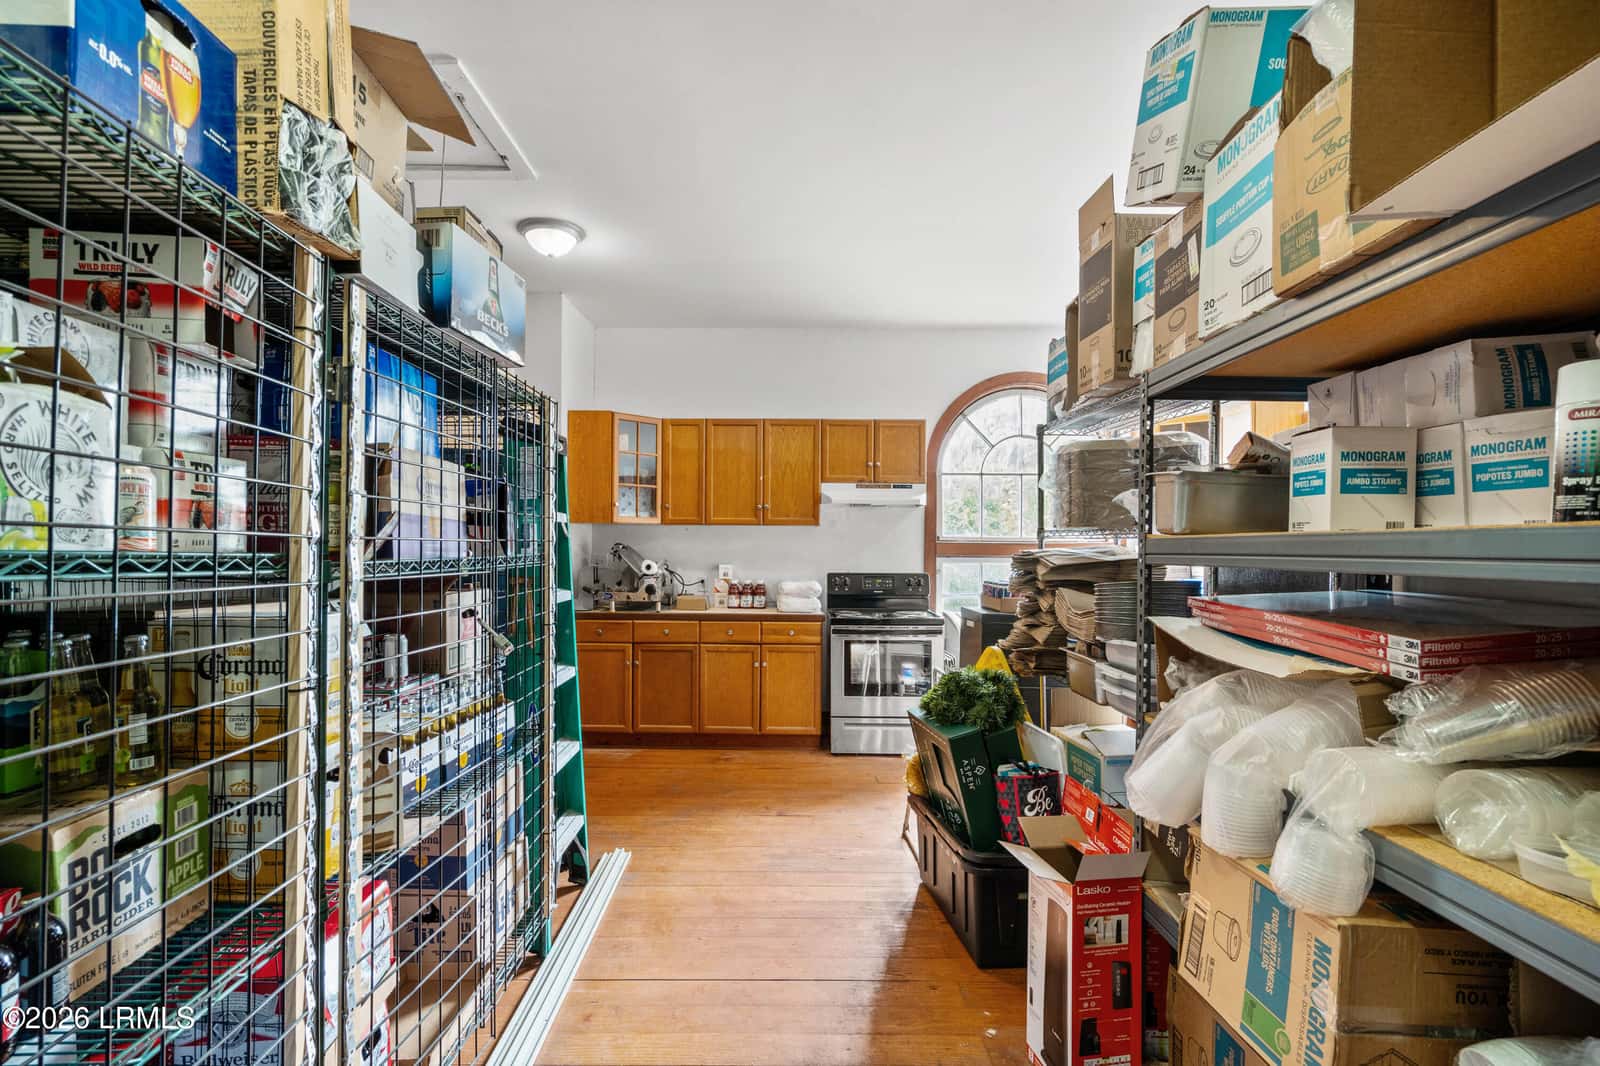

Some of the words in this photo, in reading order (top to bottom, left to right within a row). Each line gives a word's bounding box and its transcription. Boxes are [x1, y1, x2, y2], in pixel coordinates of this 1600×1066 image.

[1210, 10, 1264, 22] MONOGRAM
[262, 11, 277, 104] COUVERCLES
[243, 69, 257, 112] TAPAS
[263, 106, 277, 125] EN
[244, 117, 257, 135] DE
[263, 130, 276, 208] PLASTIQUE
[1183, 165, 1196, 175] 24
[1203, 298, 1215, 311] 20
[1495, 347, 1516, 409] MONOGRAM
[37, 399, 97, 447] WHITE
[4, 415, 27, 454] HARD
[1471, 436, 1547, 457] MONOGRAM
[1292, 452, 1325, 467] MONOGRAM
[1340, 451, 1406, 462] MONOGRAM
[1346, 477, 1370, 486] JUMBO
[1372, 477, 1402, 486] STRAWS
[1475, 471, 1512, 482] POPOTES
[1514, 468, 1543, 478] JUMBO
[1562, 476, 1593, 487] Spray
[1405, 640, 1419, 650] 3M
[1403, 654, 1418, 665] 3M
[1406, 670, 1419, 680] 3M
[168, 852, 204, 887] APPLE
[69, 854, 154, 941] ROCK
[1076, 885, 1112, 896] Lasko
[113, 897, 155, 927] CIDER
